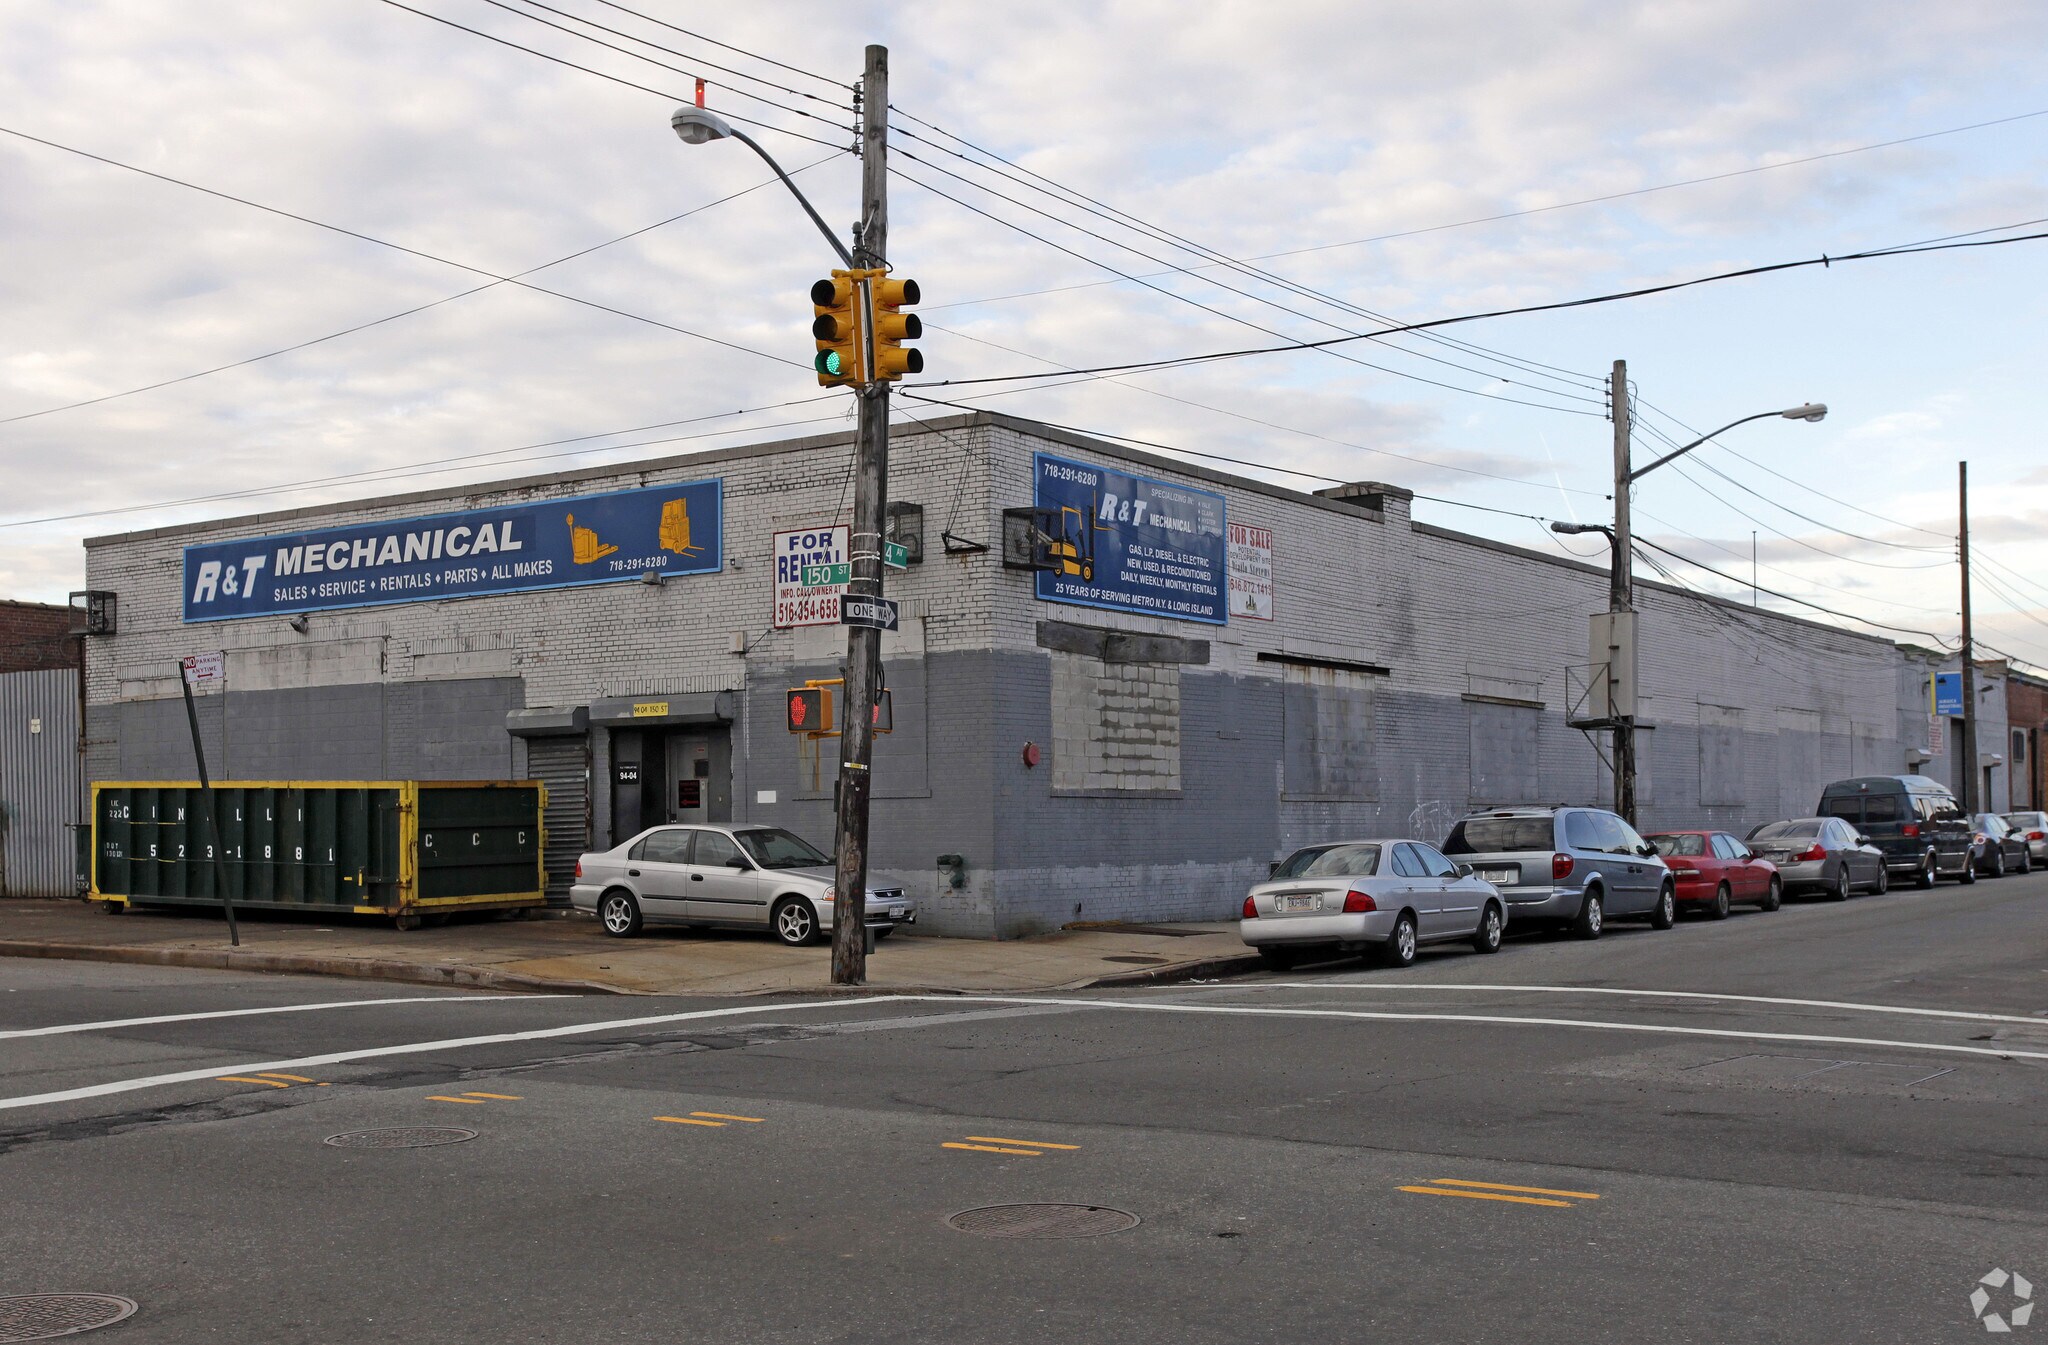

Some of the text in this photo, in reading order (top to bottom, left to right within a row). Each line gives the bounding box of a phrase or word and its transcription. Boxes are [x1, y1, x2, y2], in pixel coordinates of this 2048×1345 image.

[1044, 463, 1097, 486] 718-291-6280
[1151, 488, 1187, 503] SPECIALIZING
[1149, 513, 1191, 533] MECHANICAL
[789, 532, 833, 551] FOR
[1229, 525, 1270, 549] FOR SALE
[274, 520, 523, 577] MECHANICAL
[1128, 544, 1143, 557] GAS,
[1155, 549, 1177, 563] DIESEL,
[1177, 552, 1182, 563] &
[1183, 554, 1209, 567] ELECTRIC
[609, 555, 668, 572] 718-291-6280
[1127, 558, 1212, 581] NEW, USED, & RECONDITIONED
[274, 559, 553, 602] SALES SERVICE RENTALS PARTS ALL MAKES
[807, 565, 848, 585] 150 ST
[1120, 571, 1218, 596] DAILY, WEEKLY, MONTHLY RENTALS
[780, 585, 841, 599] INFO. CALL OWNER AT
[1055, 583, 1213, 616] 25 YEARS OF SERVING METRO N.Y. & LONG ISLAND
[778, 597, 841, 623] 516-354-658
[853, 604, 893, 621] ONE WAY
[184, 656, 221, 668] NO PARKING
[192, 666, 217, 674] ANYTIME
[660, 705, 668, 713] ST
[619, 771, 637, 780] 94-04
